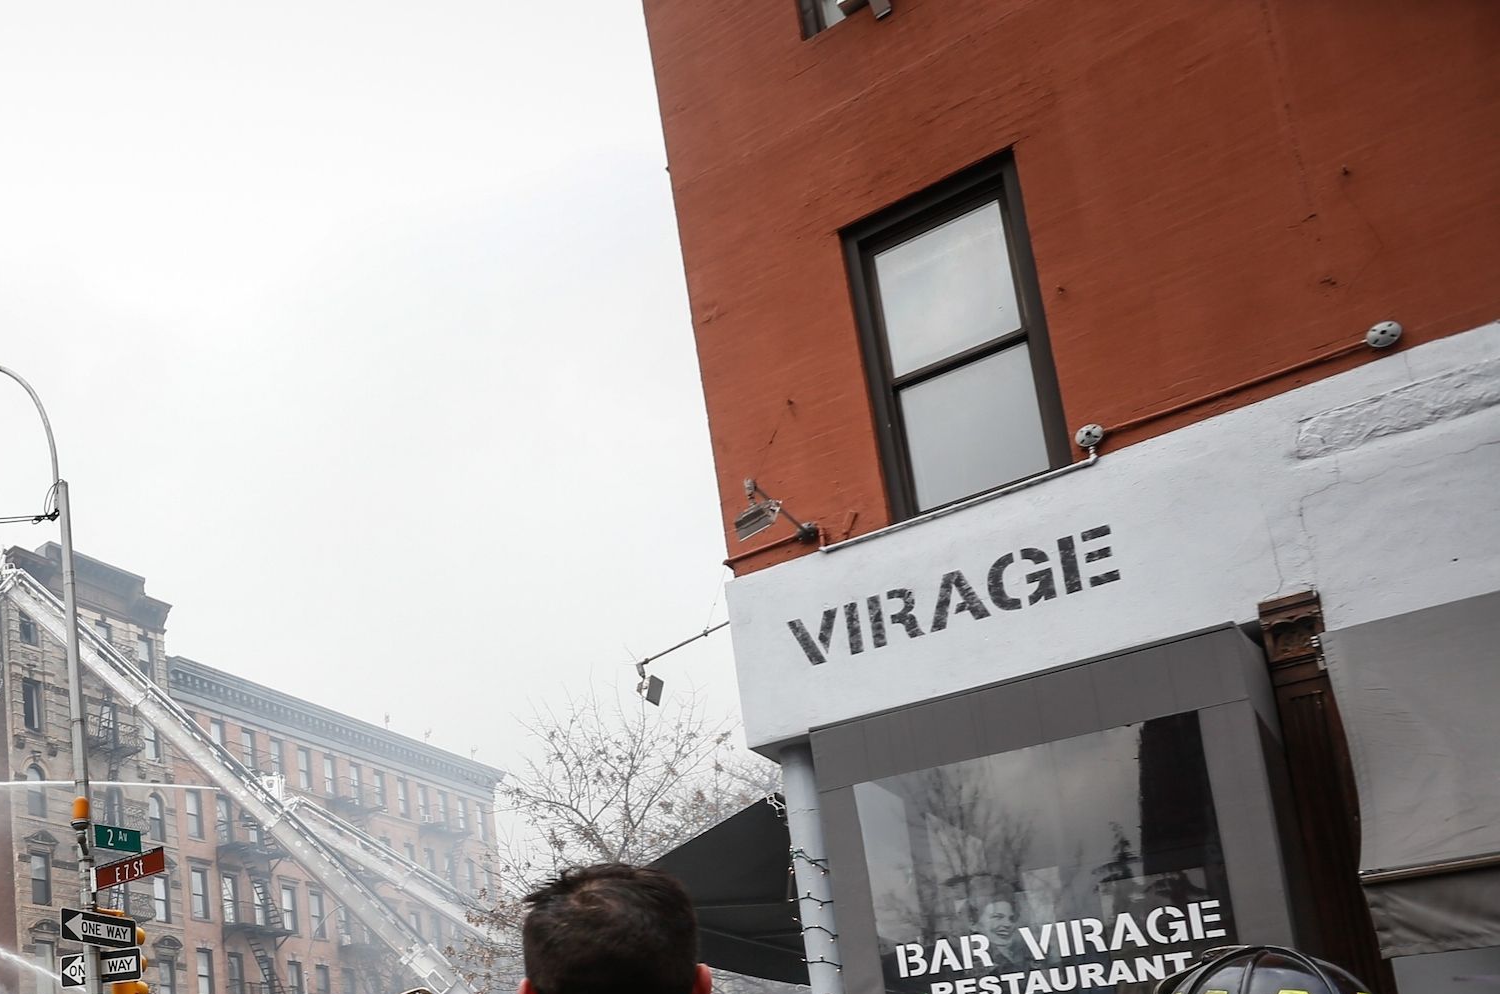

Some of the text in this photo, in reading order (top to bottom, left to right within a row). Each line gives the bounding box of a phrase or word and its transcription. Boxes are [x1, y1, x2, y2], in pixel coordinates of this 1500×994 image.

[787, 524, 1121, 666] VIRAGE
[106, 828, 128, 846] 2 Av
[115, 859, 144, 882] E 7 St
[81, 921, 128, 940] ONE WAY
[895, 900, 1227, 978] BAR VIRAGE
[69, 958, 134, 977] ON WAY
